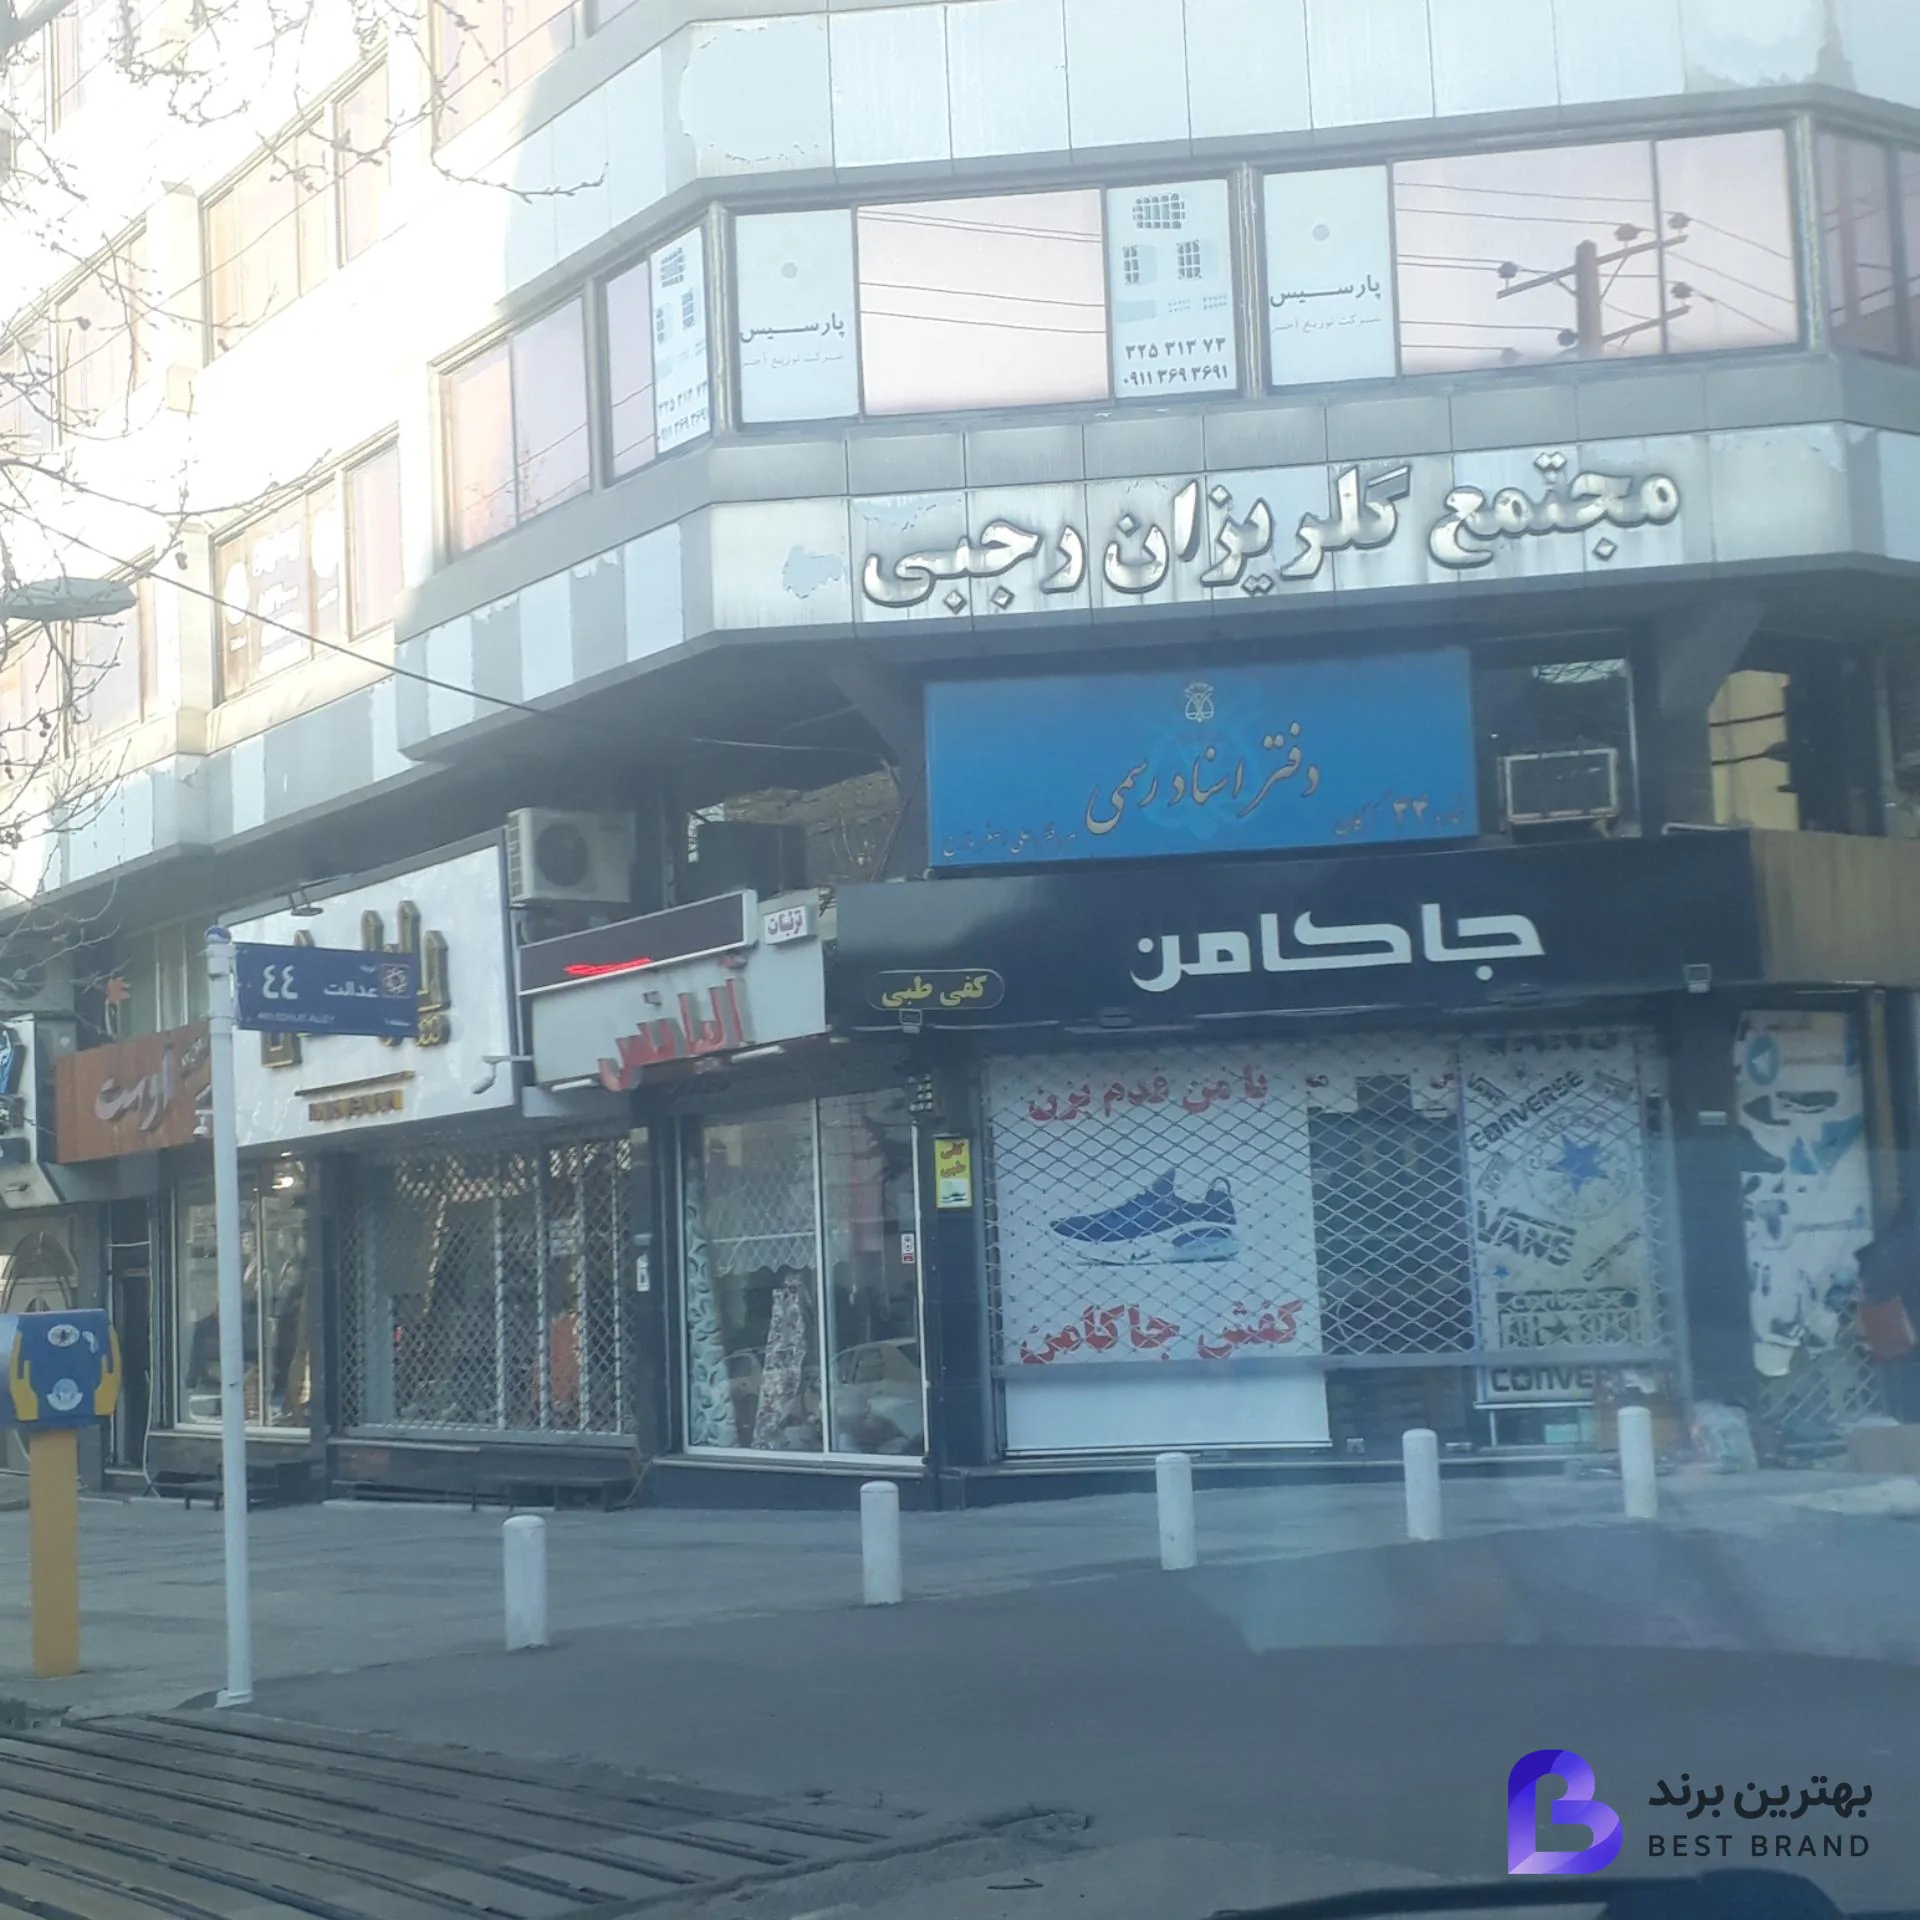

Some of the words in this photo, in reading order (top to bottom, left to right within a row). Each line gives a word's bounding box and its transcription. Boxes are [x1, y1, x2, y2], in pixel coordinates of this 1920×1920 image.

[1102, 465, 1412, 597] گلریزان
[1428, 451, 1681, 569] مجتمع
[862, 518, 1088, 615] رجبی
[1084, 760, 1159, 836] رسمی
[1167, 746, 1246, 806] اسناد
[1235, 721, 1321, 818] دفتر
[1128, 902, 1547, 993] جاکامن
[323, 980, 379, 998] عدالت
[881, 974, 934, 1008] طبی
[939, 974, 989, 1007] کفی
[1469, 1070, 1585, 1152] CONVERSE
[1197, 1299, 1303, 1360] کفش
